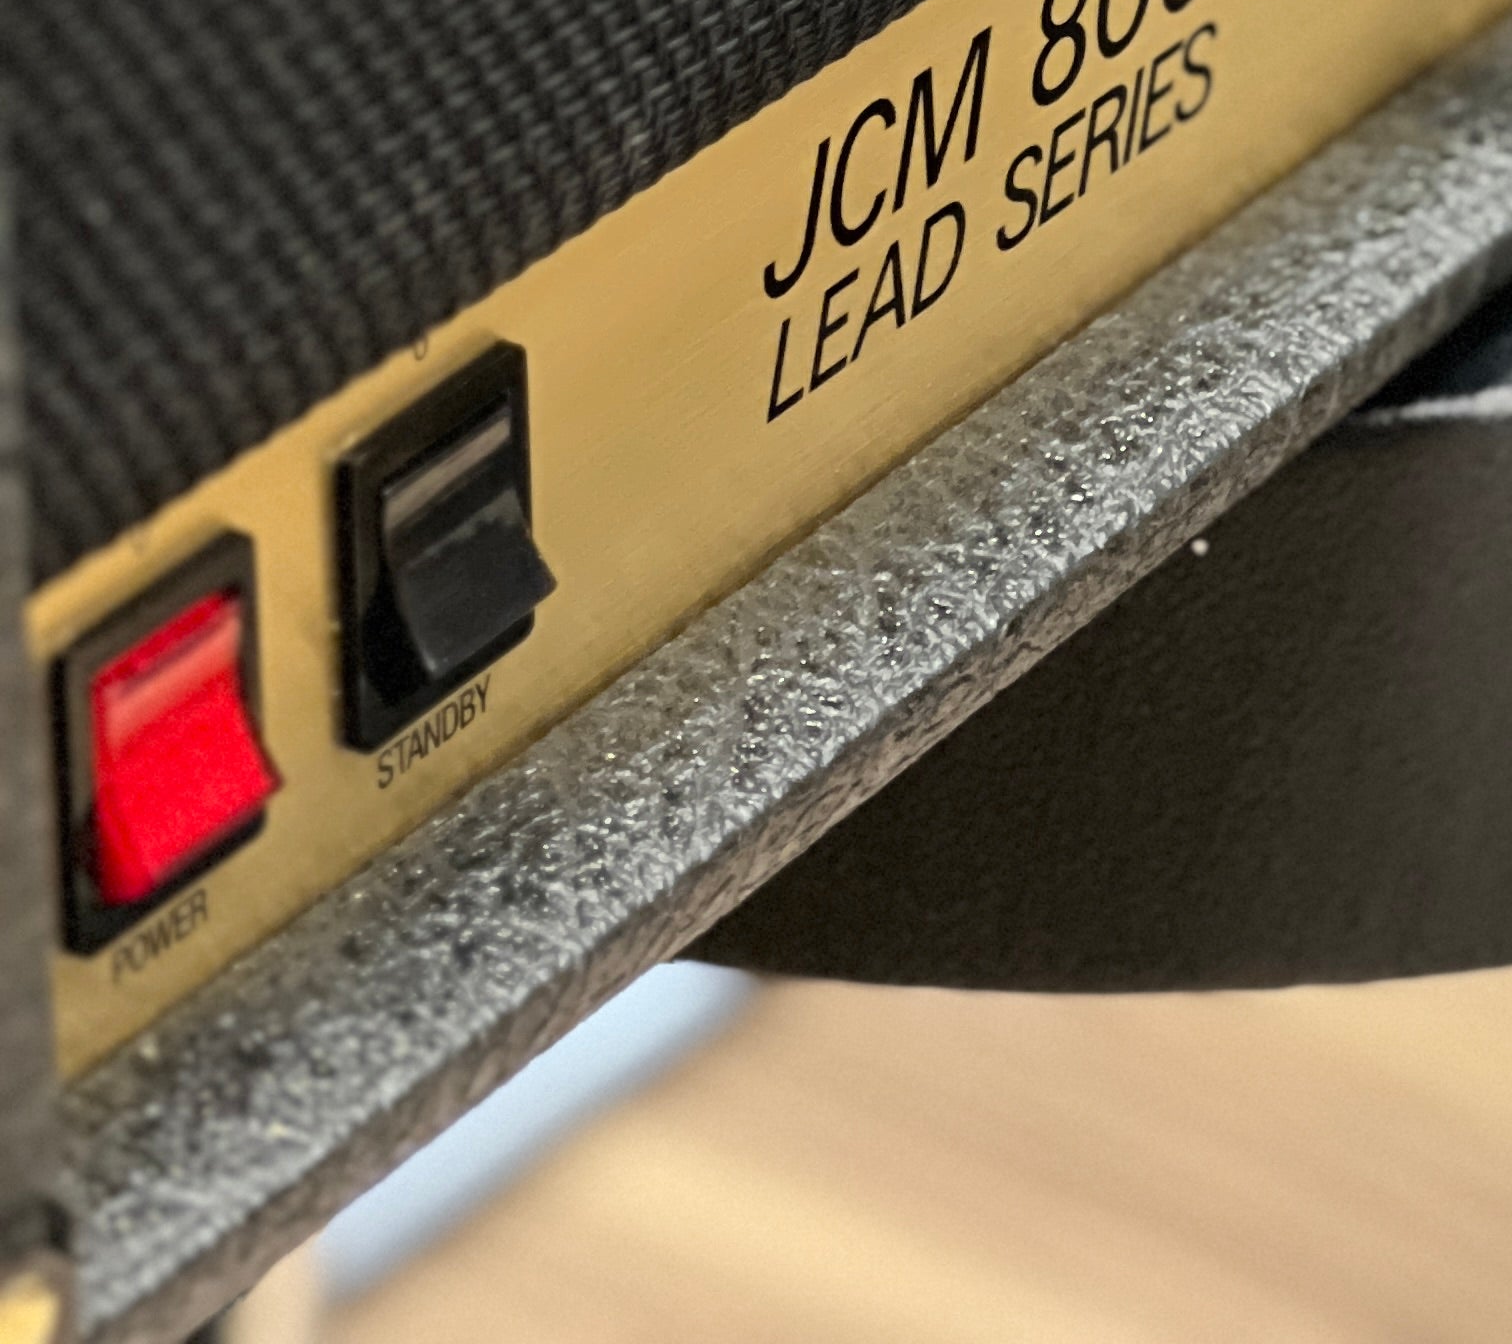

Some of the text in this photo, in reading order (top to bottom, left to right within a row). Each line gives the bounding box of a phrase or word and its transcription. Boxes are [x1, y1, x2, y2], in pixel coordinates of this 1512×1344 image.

[763, 26, 993, 299] JCM
[766, 21, 1218, 424] LEAD SERIES
[376, 676, 491, 790] STANDBY
[110, 889, 209, 979] POWER
